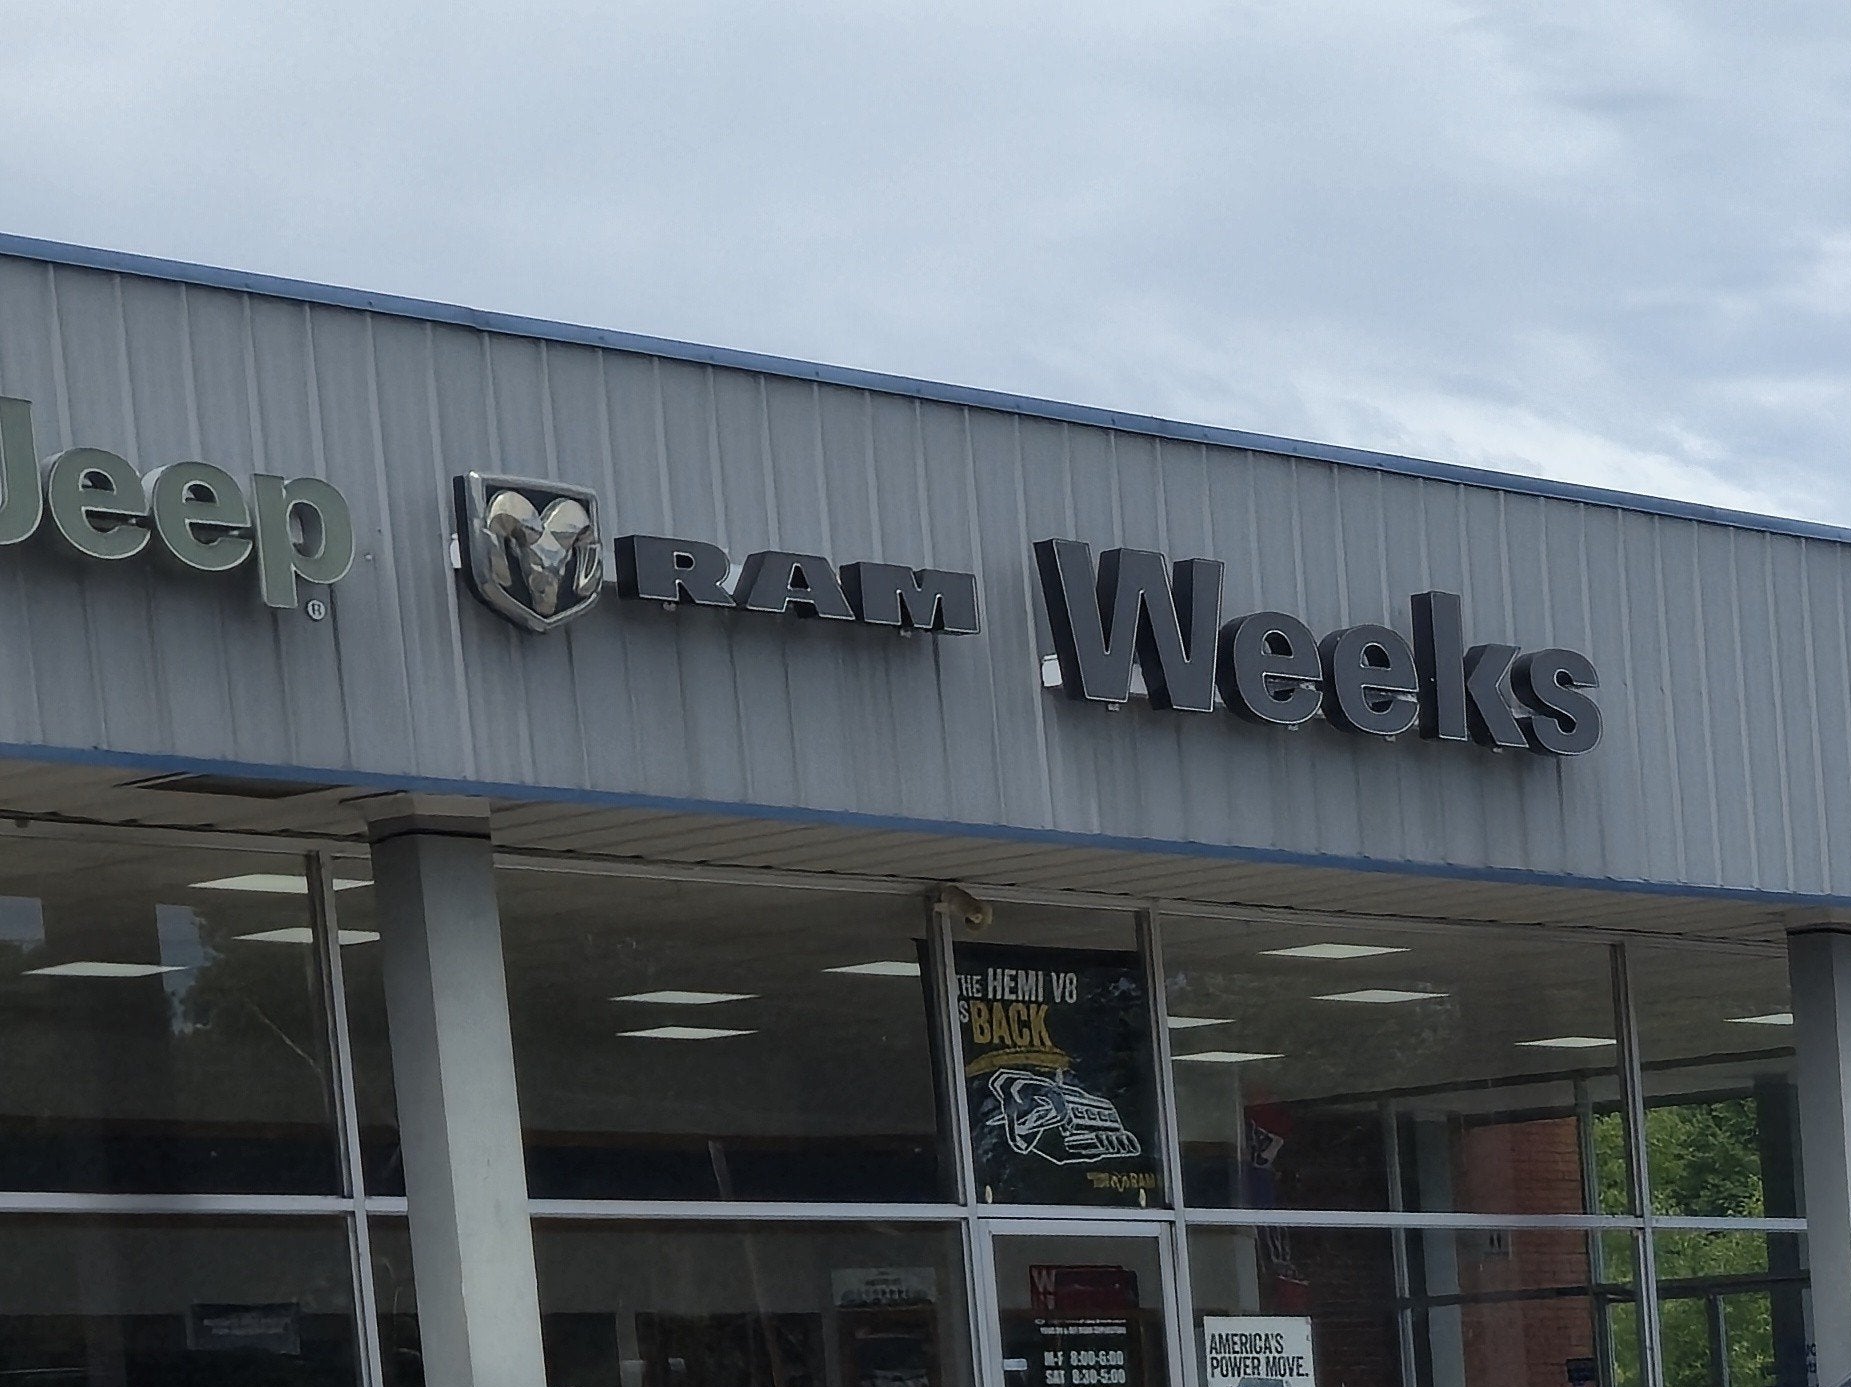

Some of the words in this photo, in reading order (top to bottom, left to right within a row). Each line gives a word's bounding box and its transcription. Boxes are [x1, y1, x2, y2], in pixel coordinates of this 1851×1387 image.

[0, 395, 356, 610] Jeep
[614, 534, 980, 634] RAM
[1034, 538, 1602, 756] Weeks
[987, 967, 1044, 1002] HEMI
[1050, 972, 1077, 1004] V8
[958, 1000, 969, 1023] S
[969, 1000, 1053, 1048] BACK
[1209, 1332, 1284, 1355] AMERICA'S
[1210, 1355, 1261, 1378] POWER
[1265, 1356, 1309, 1378] MOVE.
